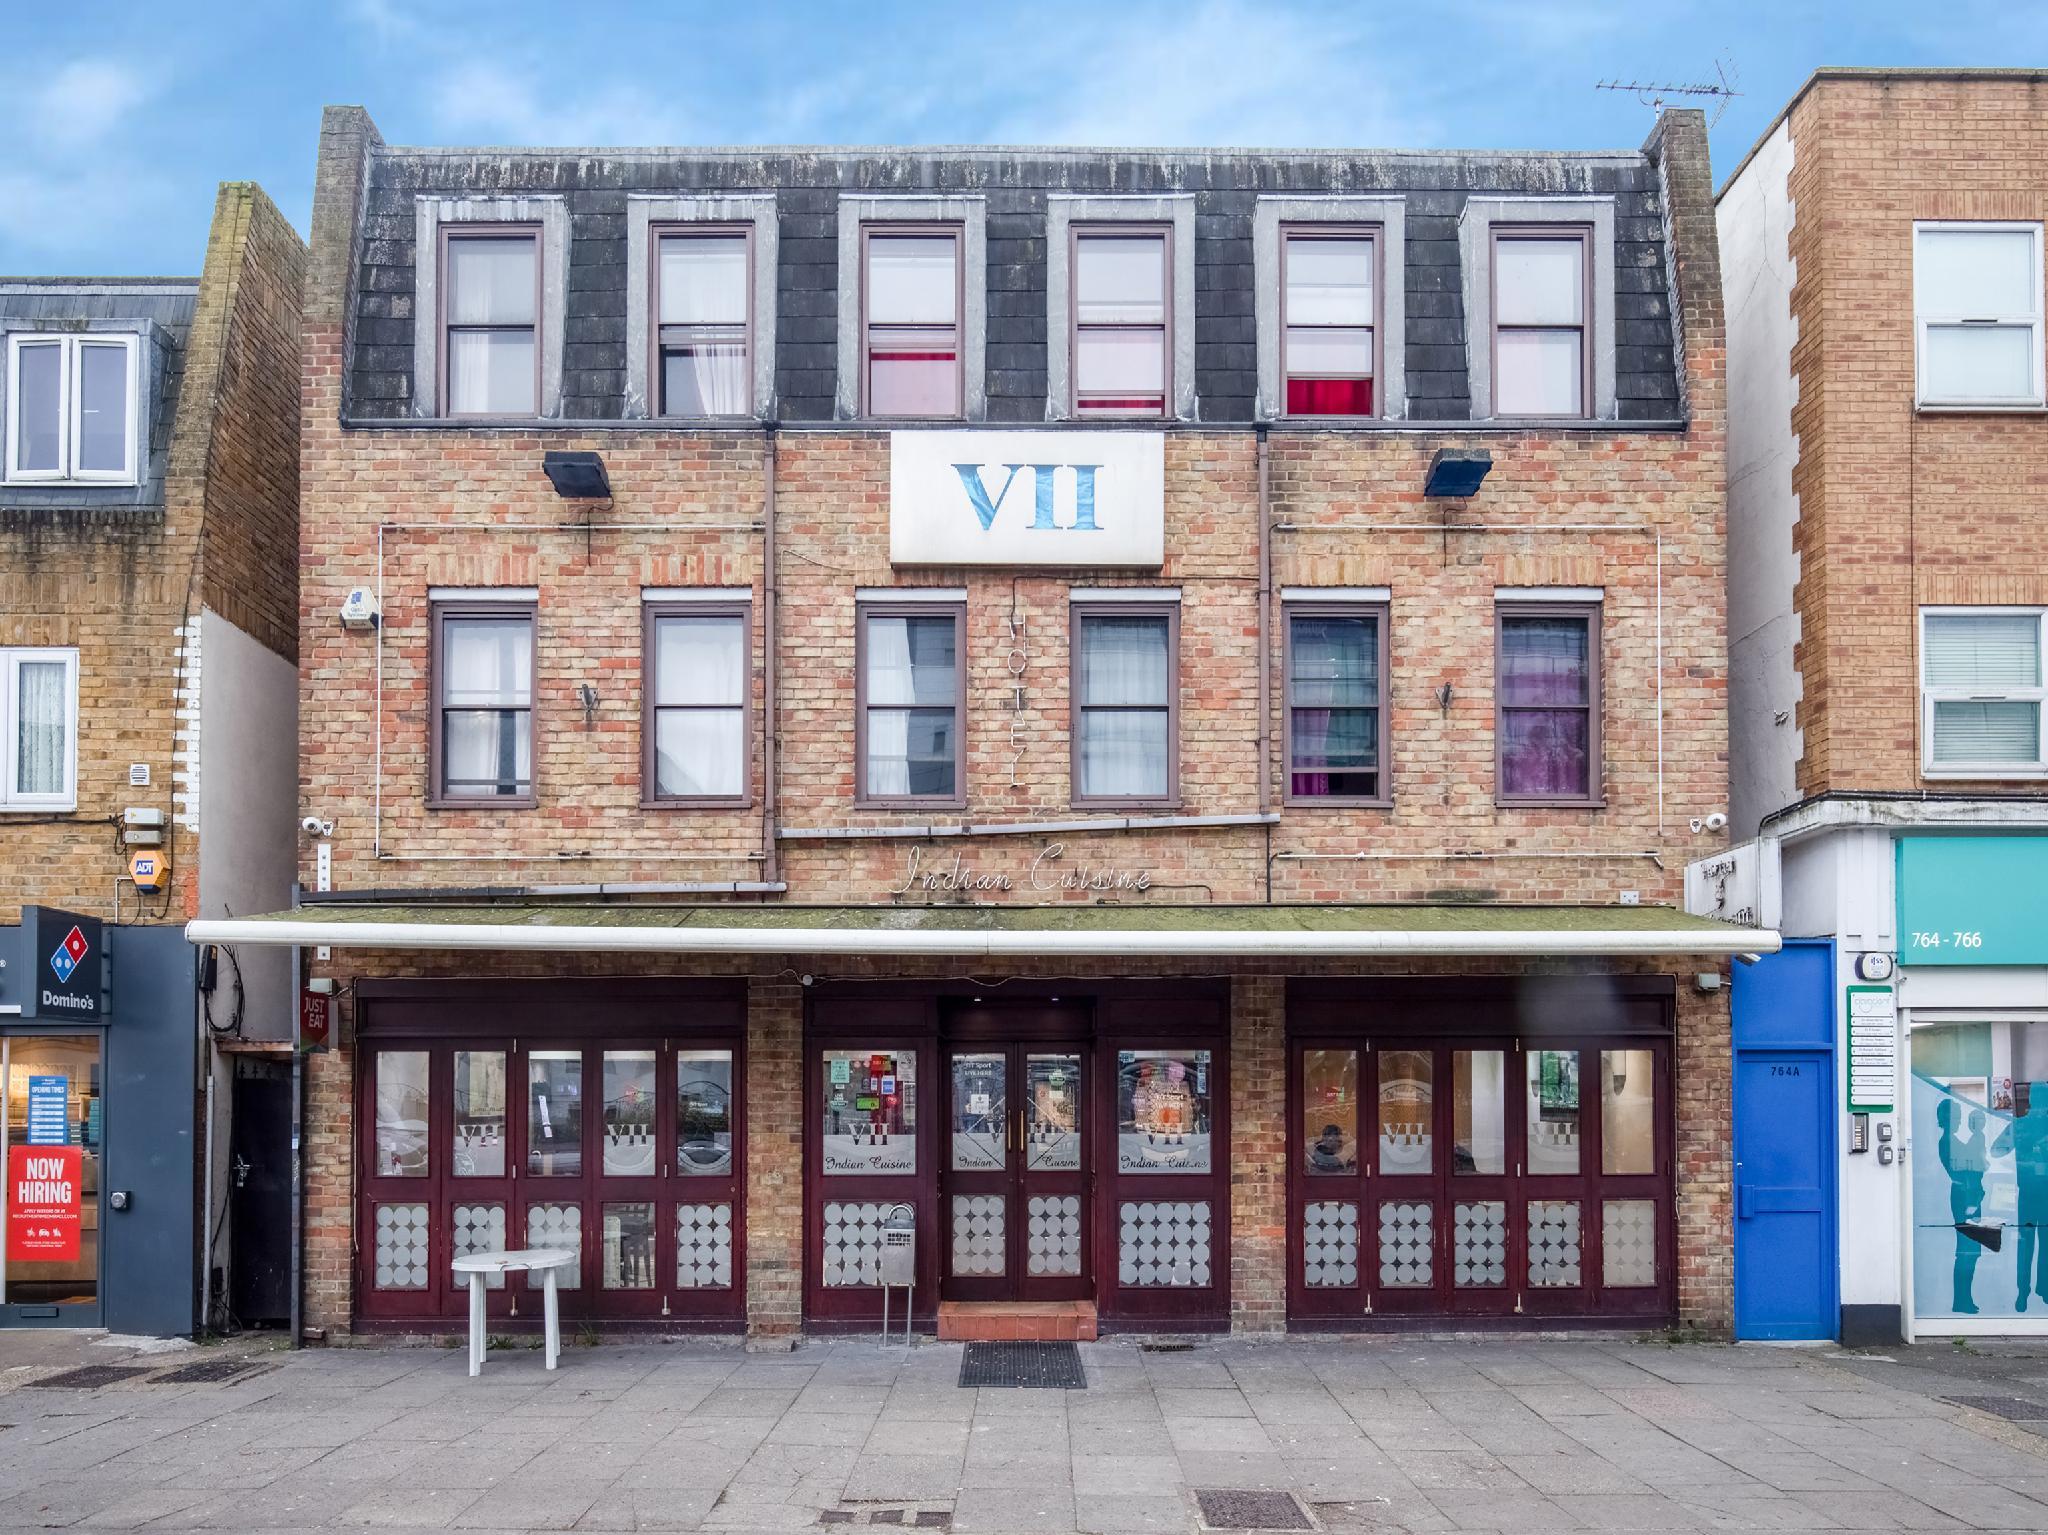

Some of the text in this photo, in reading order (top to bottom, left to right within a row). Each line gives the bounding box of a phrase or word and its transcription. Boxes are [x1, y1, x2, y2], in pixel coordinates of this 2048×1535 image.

[950, 463, 1105, 531] VII
[136, 862, 153, 874] ADT
[888, 842, 1151, 894] Indian Cuisine
[1912, 932, 1940, 948] 764
[1953, 931, 1982, 948] 766
[42, 990, 94, 1010] Domino's
[304, 997, 325, 1013] JUST
[308, 1013, 325, 1028] EAT
[1771, 1066, 1800, 1076] 764A
[606, 1123, 649, 1147] VII
[848, 1123, 890, 1146] VII
[1383, 1122, 1425, 1146] VII
[1531, 1122, 1574, 1146] VII
[26, 1158, 65, 1180] NOW
[825, 1155, 914, 1169] Indian Cuisine
[958, 1156, 993, 1168] Indian
[1120, 1155, 1160, 1169] Indian
[18, 1181, 72, 1204] HIRING
